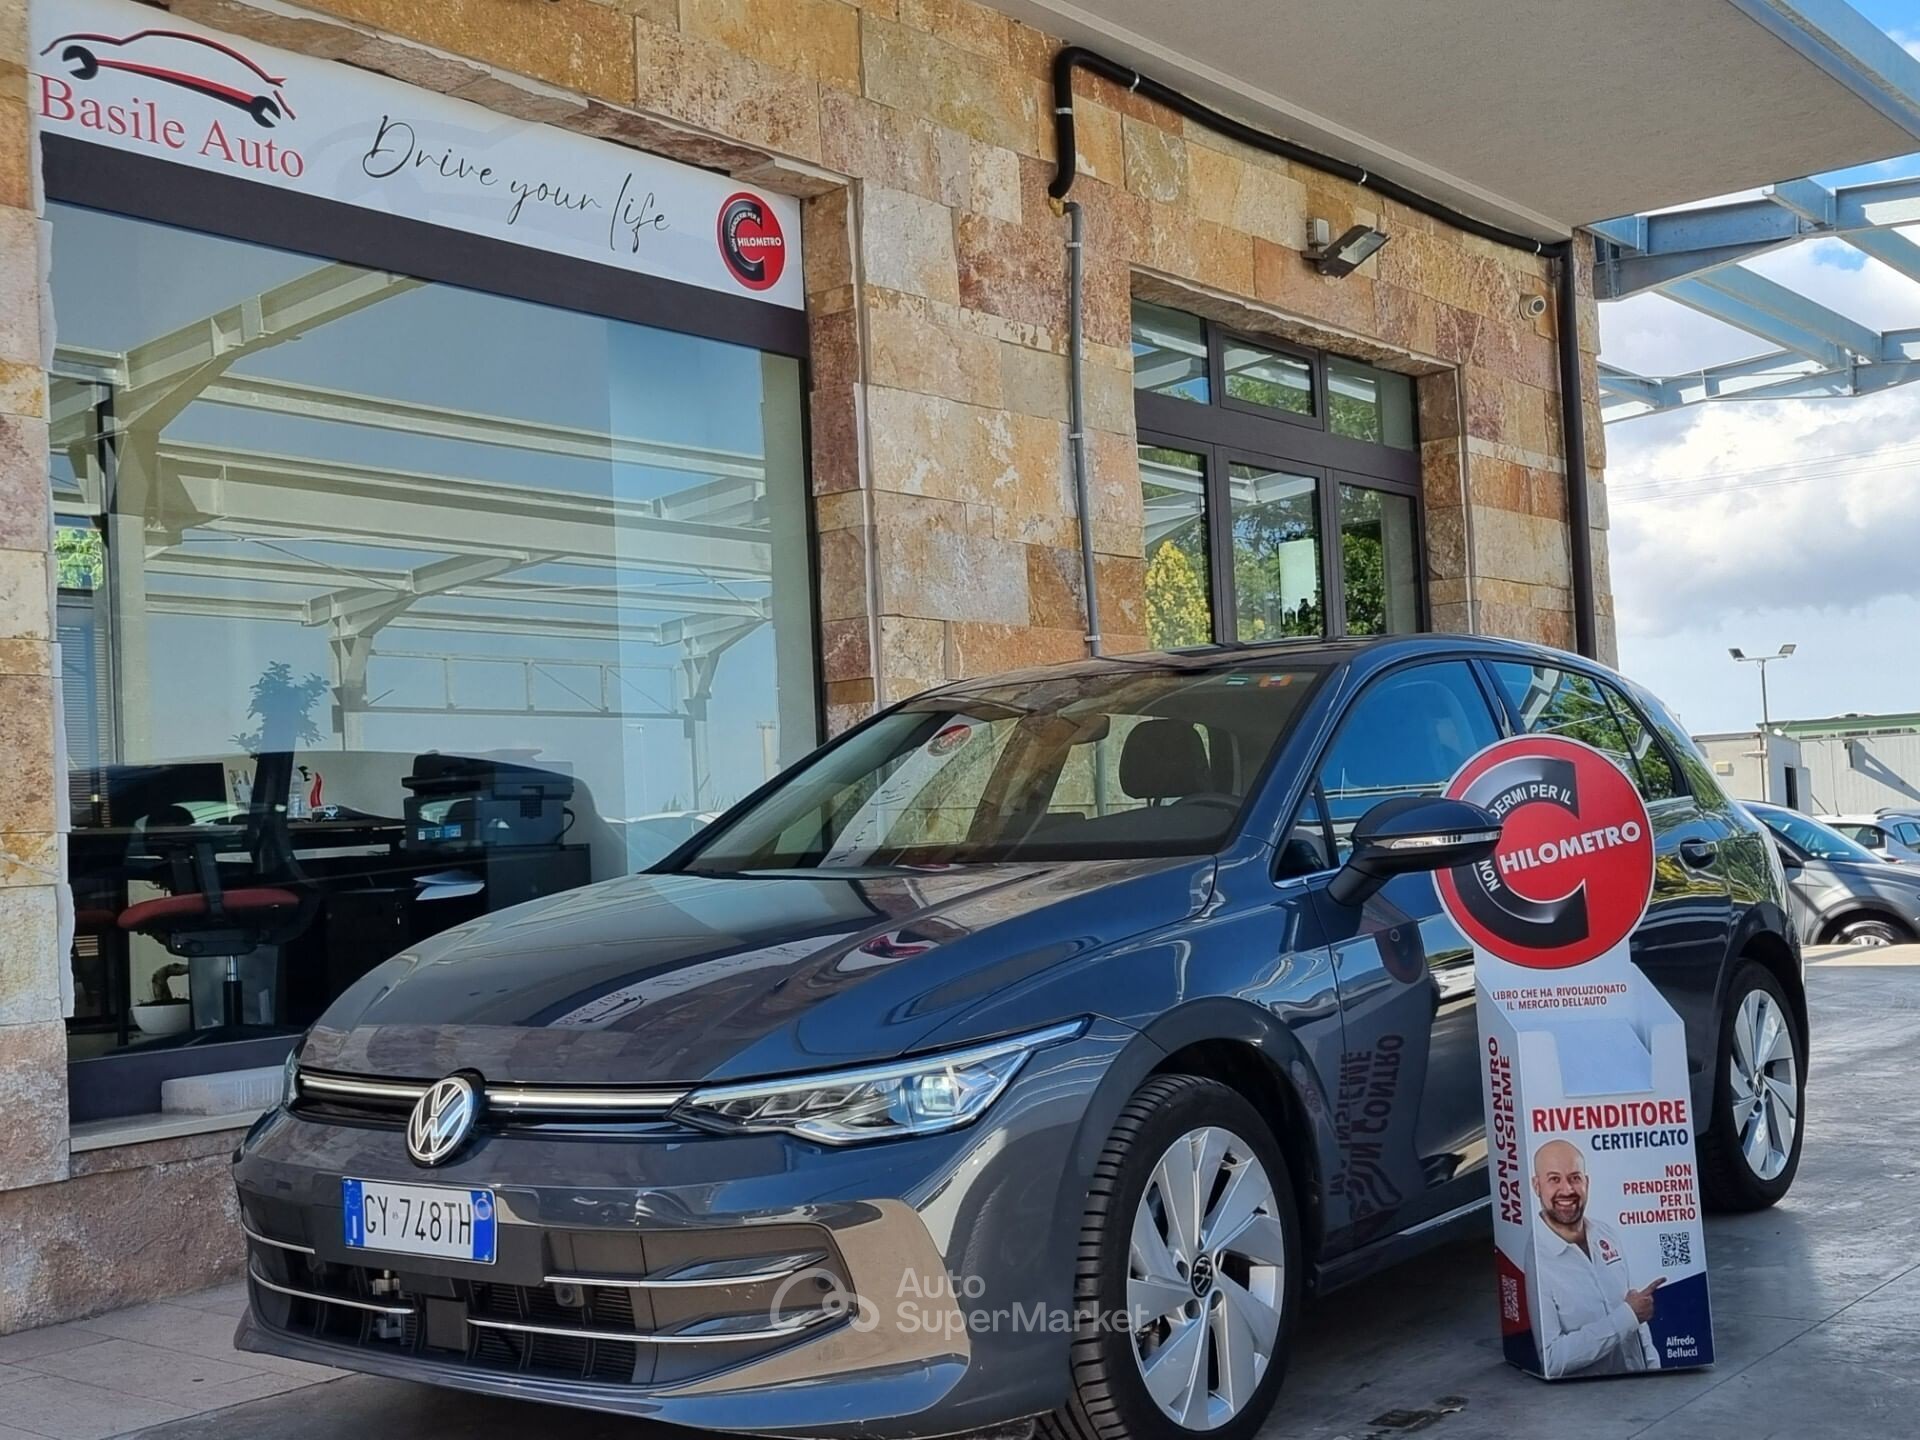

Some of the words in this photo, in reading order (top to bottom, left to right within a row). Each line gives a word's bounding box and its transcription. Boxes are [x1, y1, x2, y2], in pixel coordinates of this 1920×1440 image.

[32, 73, 186, 149] Basile
[198, 119, 305, 178] Auto
[362, 115, 498, 186] Drive
[507, 179, 603, 225] your
[609, 172, 670, 253] life
[1478, 859, 1501, 892] NON
[1530, 784, 1558, 800] PER
[1560, 788, 1572, 805] IL
[1492, 990, 1519, 1000] LIBRO
[1521, 989, 1538, 999] CHE
[1540, 988, 1552, 998] HA
[1556, 984, 1627, 997] RIVOLUZIONATO
[1506, 1000, 1515, 1010] IL
[1518, 998, 1560, 1010] MERCATO
[1562, 996, 1607, 1008] DELL'AUTO
[1488, 1037, 1506, 1151] CONTRO
[1500, 1055, 1518, 1171] INSIEME
[1532, 1100, 1687, 1133] RIVENDITORE
[1591, 1129, 1688, 1151] CERTIFICATO
[1665, 1164, 1691, 1177] NON
[1497, 1159, 1512, 1222] NON
[1623, 1179, 1693, 1195] PRENDERMI
[1509, 1180, 1523, 1226] MA
[1660, 1194, 1682, 1207] PER
[1685, 1193, 1696, 1205] IL
[1619, 1207, 1696, 1225] CHILOMETRO
[1666, 1335, 1695, 1347] Alfredo
[1667, 1346, 1698, 1359] Bellucci
